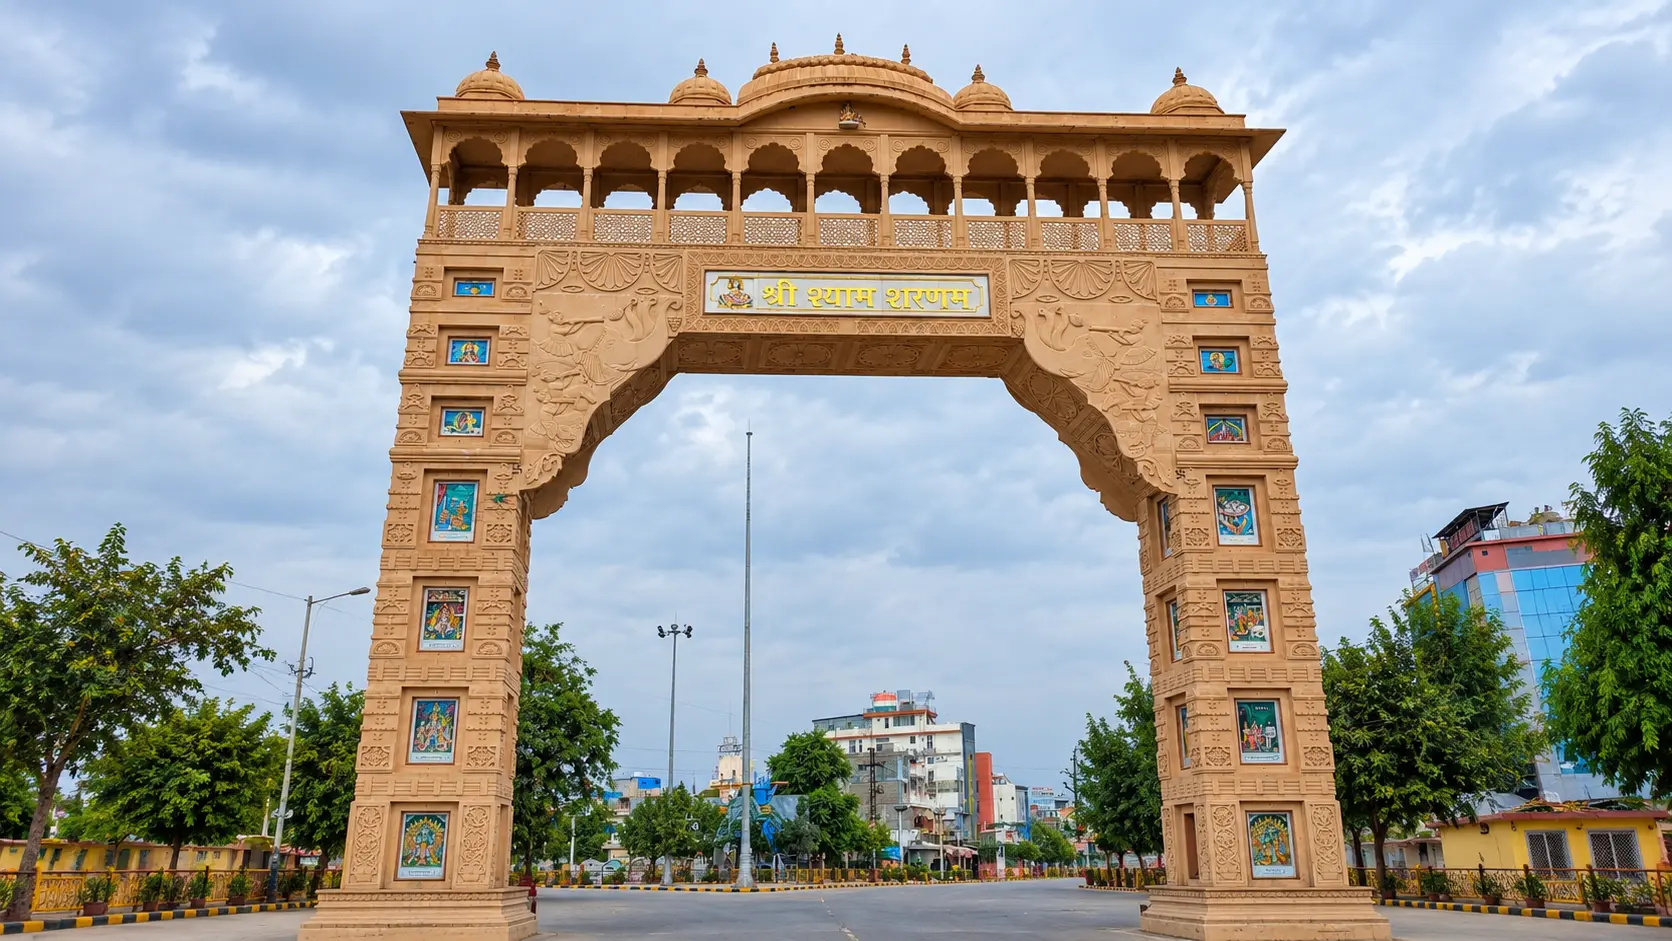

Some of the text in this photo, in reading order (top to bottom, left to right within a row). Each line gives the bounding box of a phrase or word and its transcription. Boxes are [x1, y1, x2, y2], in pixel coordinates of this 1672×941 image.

[762, 279, 972, 310] श्री श्याम शरणम
